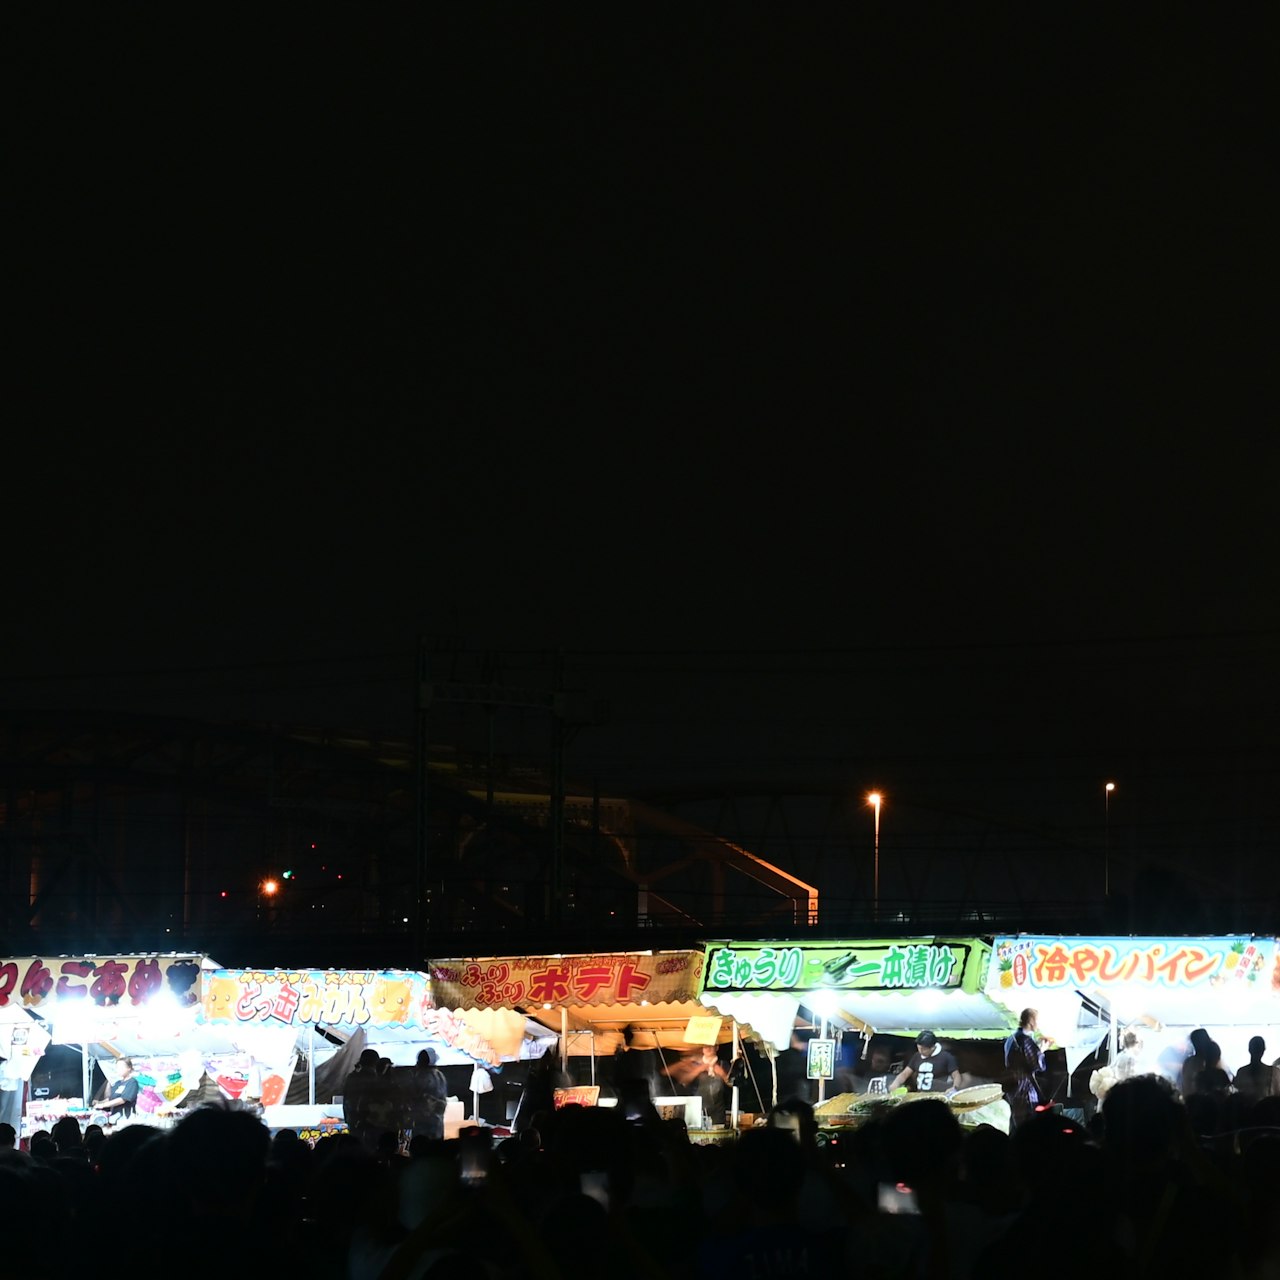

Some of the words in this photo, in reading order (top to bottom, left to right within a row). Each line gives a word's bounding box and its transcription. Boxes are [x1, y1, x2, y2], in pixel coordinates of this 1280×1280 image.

[525, 963, 652, 1004] ポテト
[711, 946, 804, 988] きゅうり
[849, 945, 955, 988] 一本漬け
[1033, 945, 1218, 983] 冷やしパイン
